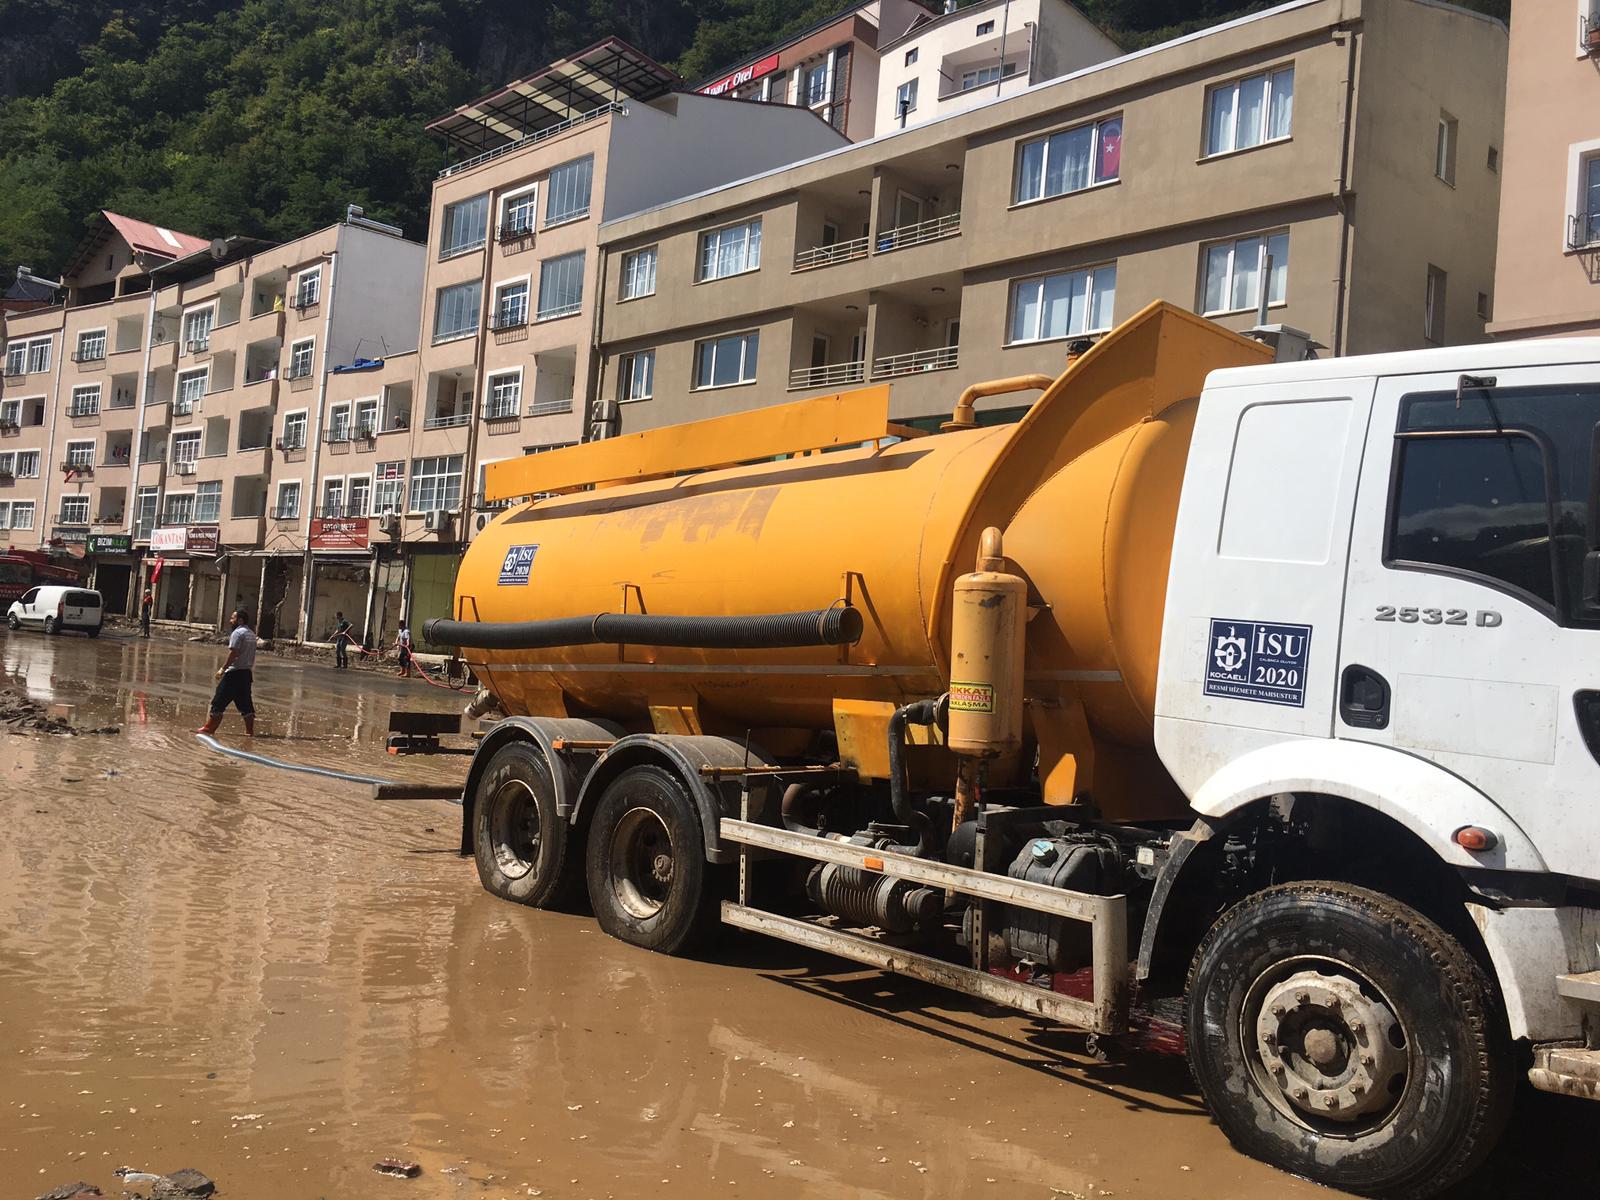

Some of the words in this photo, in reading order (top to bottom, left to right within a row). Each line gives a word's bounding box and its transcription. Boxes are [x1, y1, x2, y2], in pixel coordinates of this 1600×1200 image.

[732, 66, 754, 87] Otel
[1374, 605, 1468, 626] 2532
[1475, 609, 1503, 628] D
[1256, 626, 1306, 658] İSU
[1255, 666, 1298, 687] 2020
[1208, 684, 1228, 693] RESMİ
[1228, 685, 1258, 696] HİZMETE
[1258, 689, 1298, 701] MAHSUSTUR
